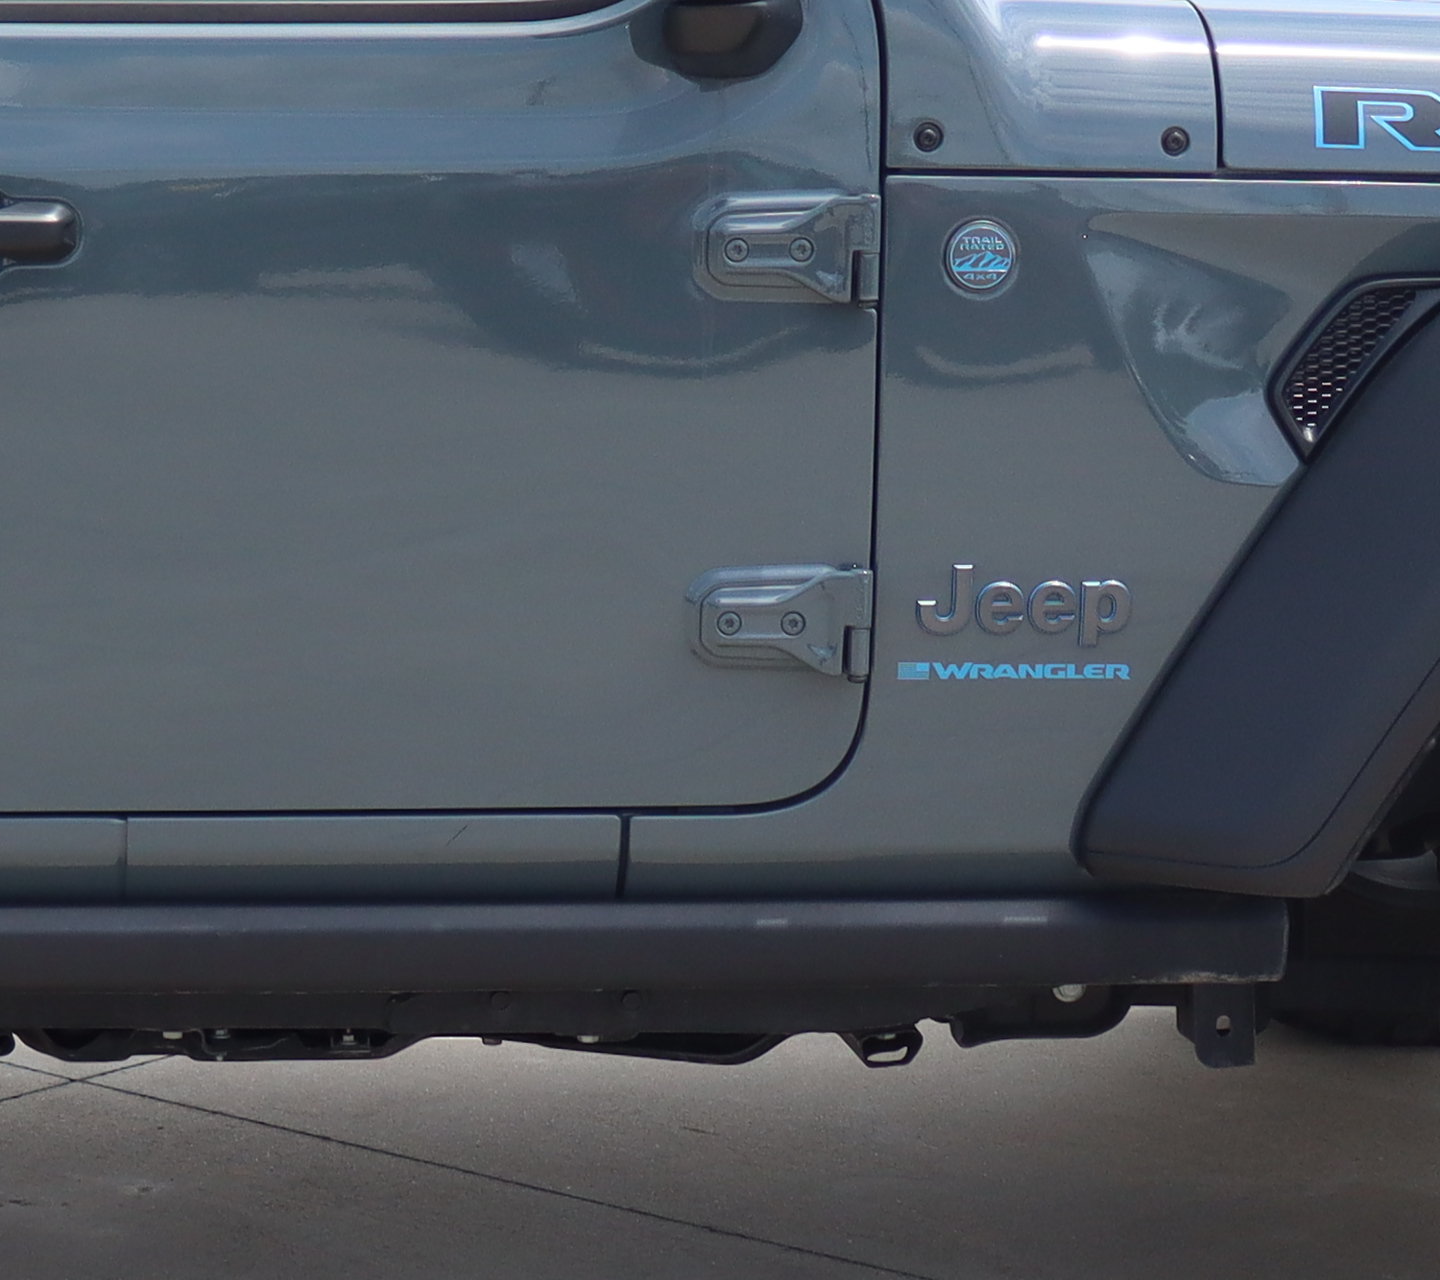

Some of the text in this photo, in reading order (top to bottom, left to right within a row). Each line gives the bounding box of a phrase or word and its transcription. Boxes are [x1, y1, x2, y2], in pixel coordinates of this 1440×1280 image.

[960, 243, 1005, 251] RATED
[962, 236, 1002, 244] TRAIL
[915, 563, 1132, 648] Jeep
[931, 661, 1131, 681] WRANGLER
